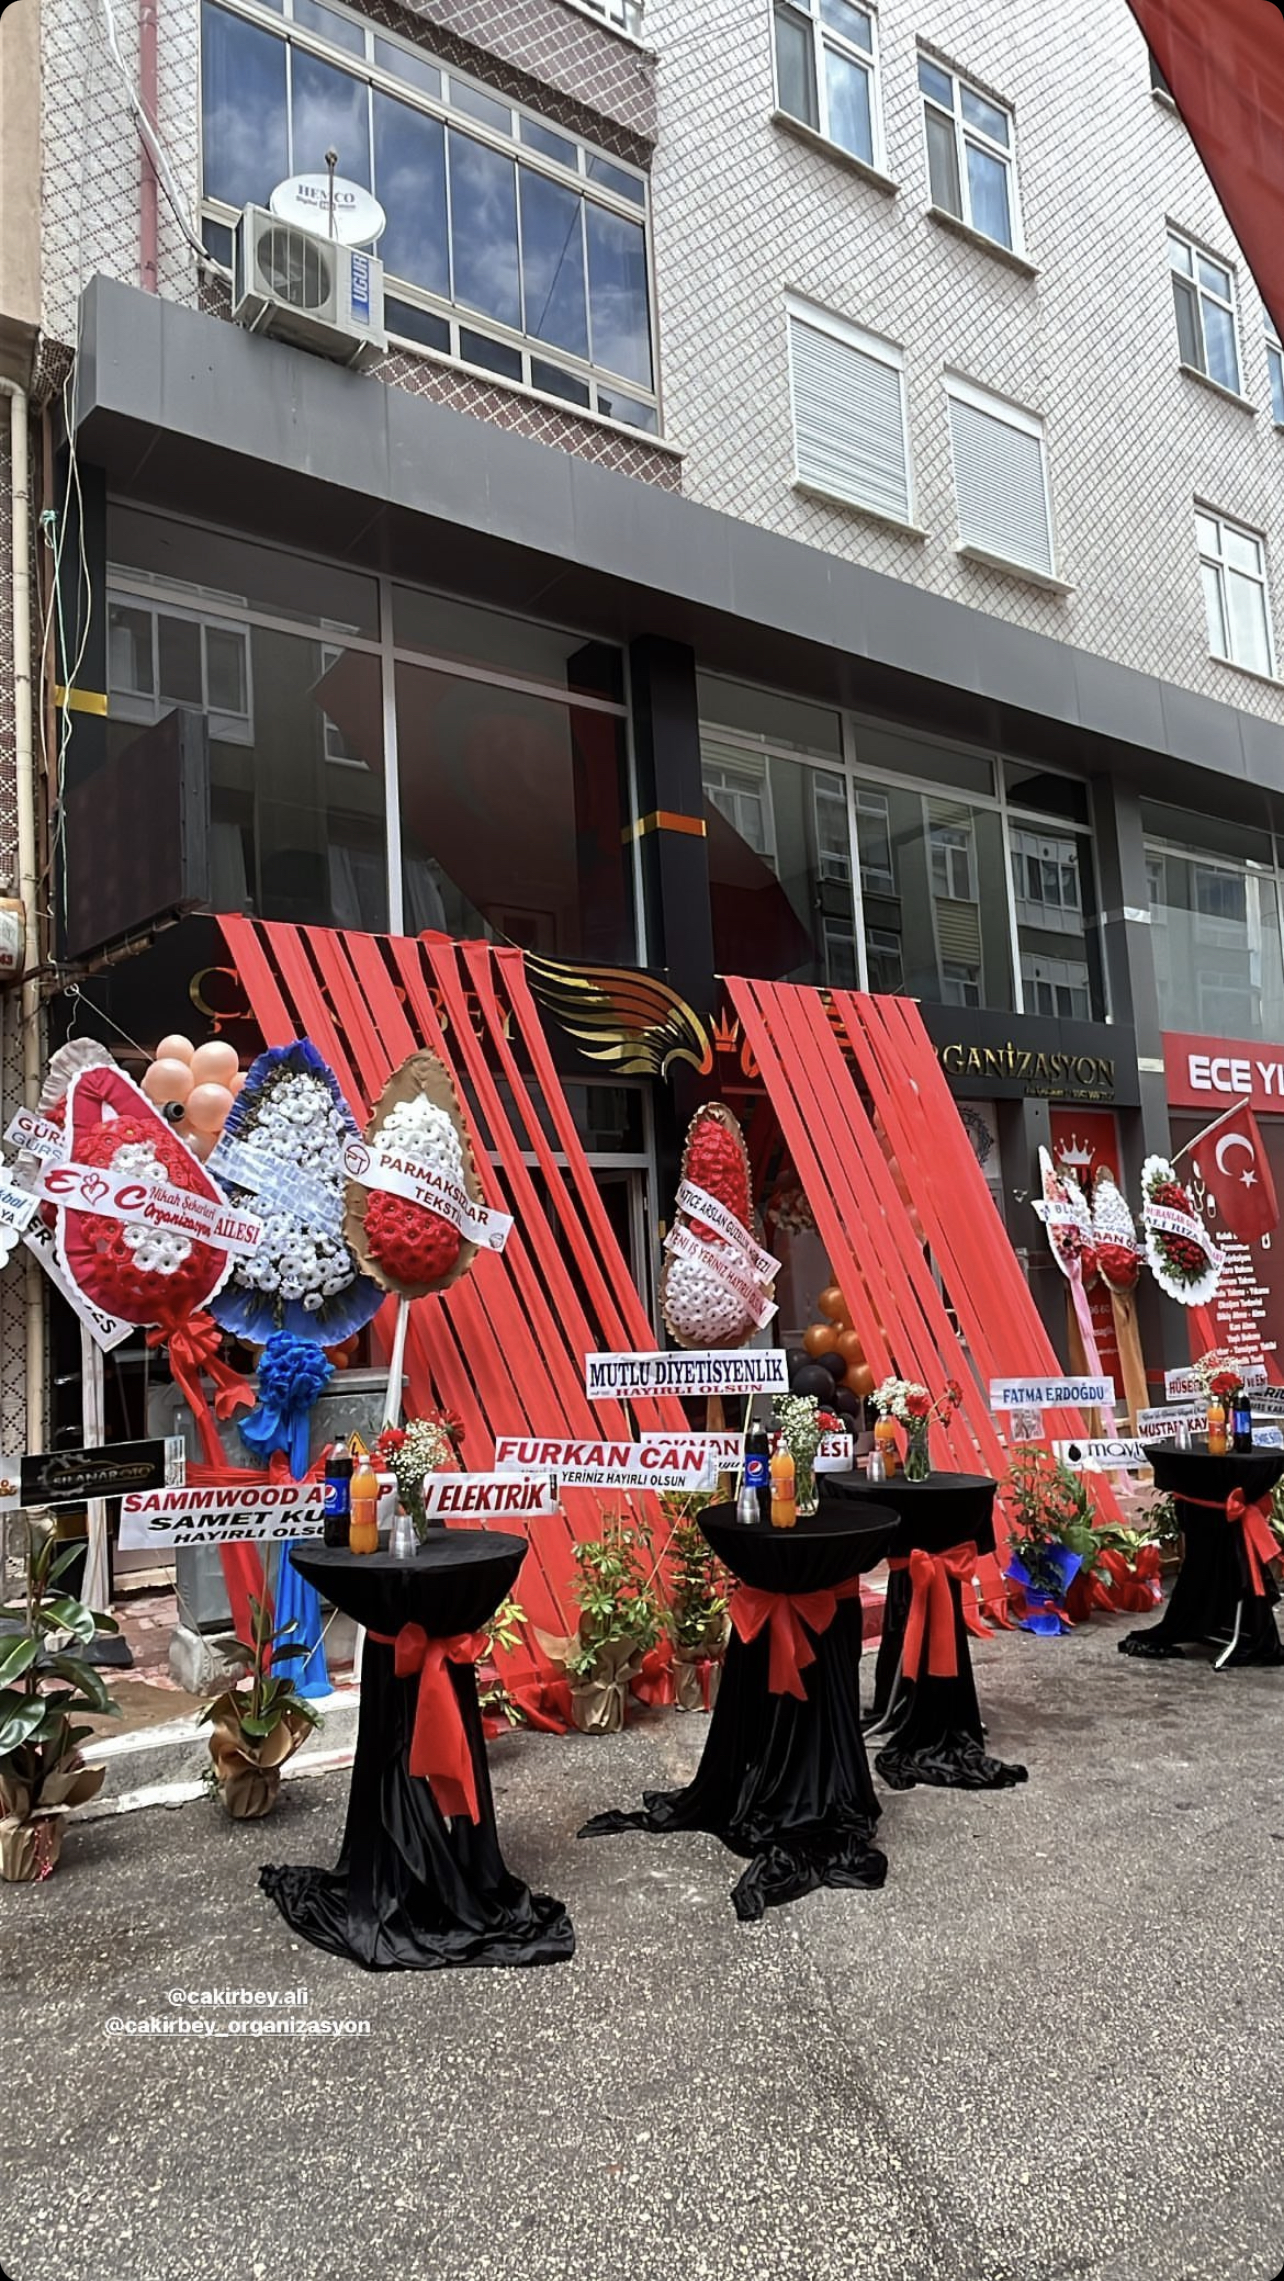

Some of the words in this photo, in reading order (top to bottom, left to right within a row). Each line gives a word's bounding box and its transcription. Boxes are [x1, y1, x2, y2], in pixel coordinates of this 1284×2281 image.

[1188, 1054, 1253, 1093] ECE
[590, 1362, 650, 1388] MUTLU
[655, 1351, 784, 1386] DİYETİSYENLİK
[615, 1387, 693, 1397] HAYIRLI
[699, 1384, 763, 1394] OLSUN
[1003, 1387, 1043, 1404] FATMA
[1046, 1382, 1104, 1402] ERDOĞDU
[496, 1440, 631, 1468] FURKAN
[639, 1446, 705, 1472] CAN
[561, 1468, 604, 1484] YERİNİZ
[606, 1473, 647, 1486] HAYIRLI
[650, 1475, 687, 1488] OLSUN
[123, 1487, 300, 1514] SAMMWOOD
[437, 1476, 546, 1512] ELEKTRİK
[148, 1511, 273, 1532] SAMET
[173, 1528, 266, 1545] HAYIRLI
